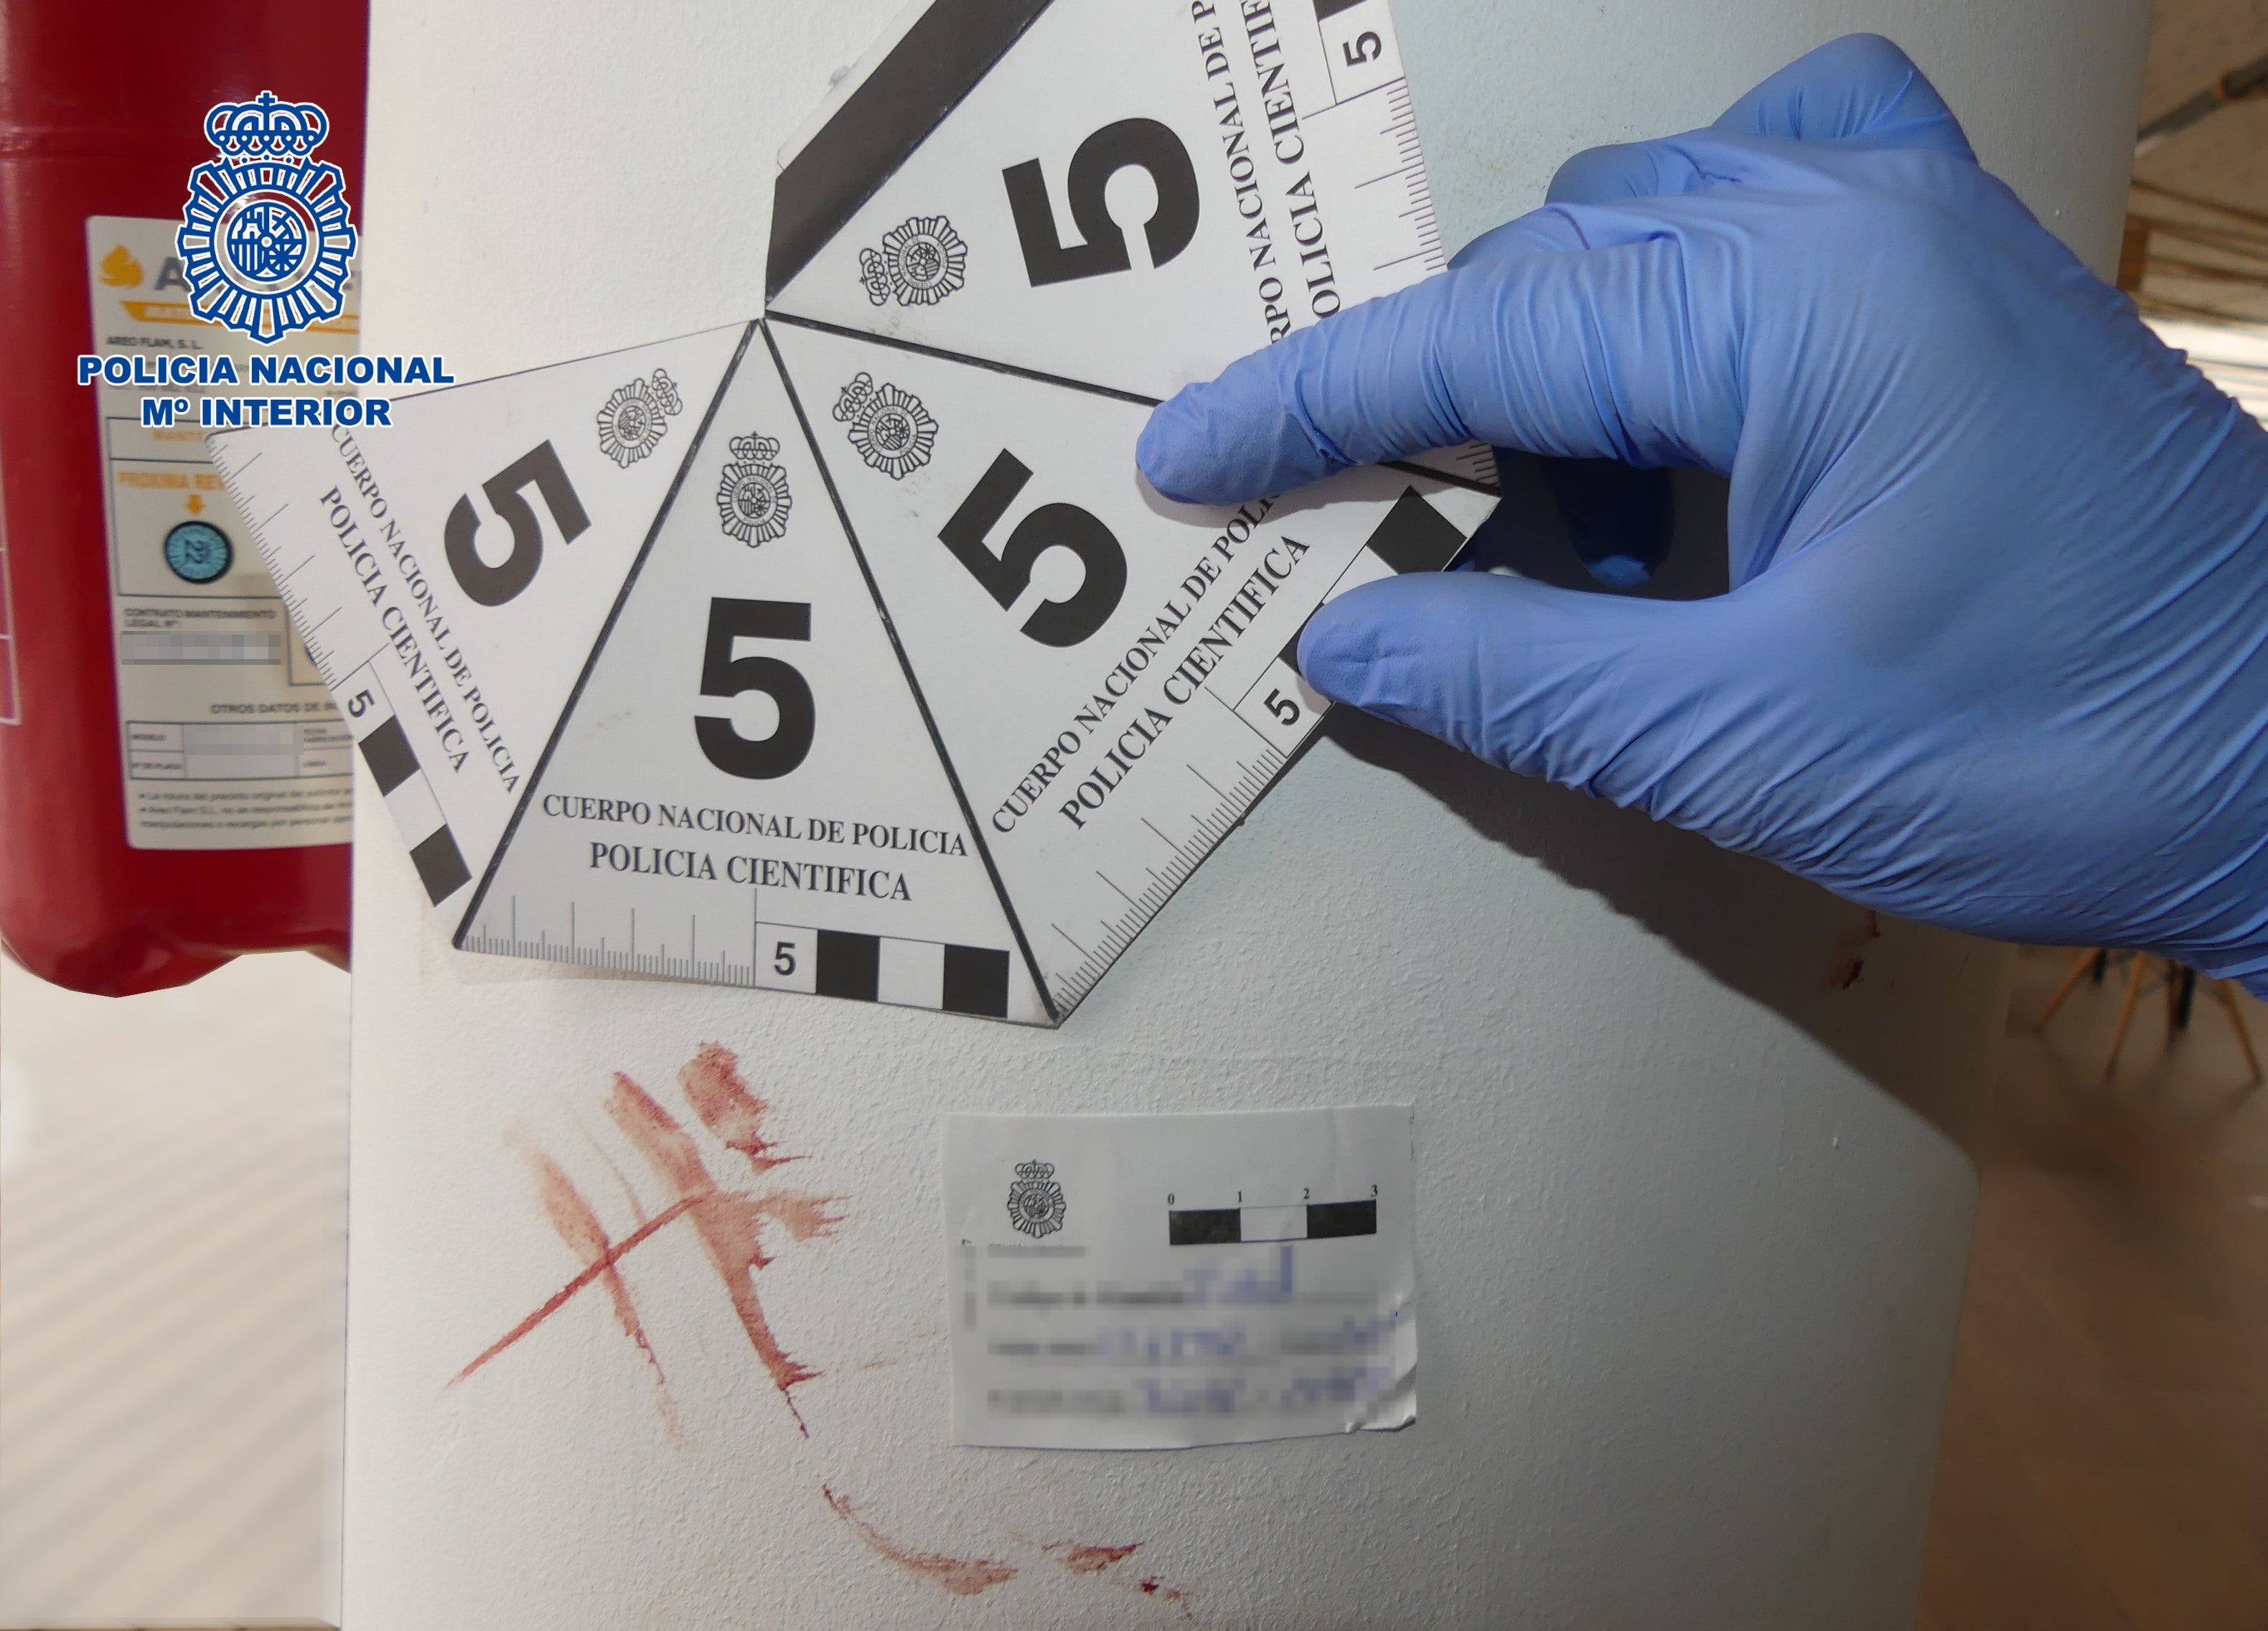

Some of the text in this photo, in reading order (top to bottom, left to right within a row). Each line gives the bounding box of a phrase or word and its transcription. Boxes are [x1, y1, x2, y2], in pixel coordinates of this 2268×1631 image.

[1198, 27, 1230, 81] DE
[1342, 32, 1382, 67] 5
[1002, 117, 1200, 287] 5
[1214, 82, 1276, 271] NACIONAL
[1240, 0, 1341, 319] OLICIA CIENTIF
[1259, 277, 1291, 345] RPO
[444, 439, 592, 607] 5
[937, 448, 1128, 648] 5
[320, 484, 390, 608] POLICIA
[382, 607, 472, 774] CIENTIFICA
[332, 424, 388, 519] CUERPO
[380, 518, 451, 648] NACIONAL
[444, 647, 473, 688] DE
[463, 686, 521, 795] POLICIA
[694, 597, 815, 780] 5
[991, 495, 1280, 833] CUERPO NACIONAL DE POLI
[1059, 535, 1310, 830] POLICIA CIENTIFICA
[348, 688, 376, 718] 5
[1263, 688, 1300, 726] 5
[543, 794, 967, 857] CUERPO NACIONAL DE POLICIA
[590, 842, 912, 902] POLICIA CIENTIFICA
[774, 941, 797, 976] 5
[1167, 1184, 1378, 1205] 0 1 2 3
